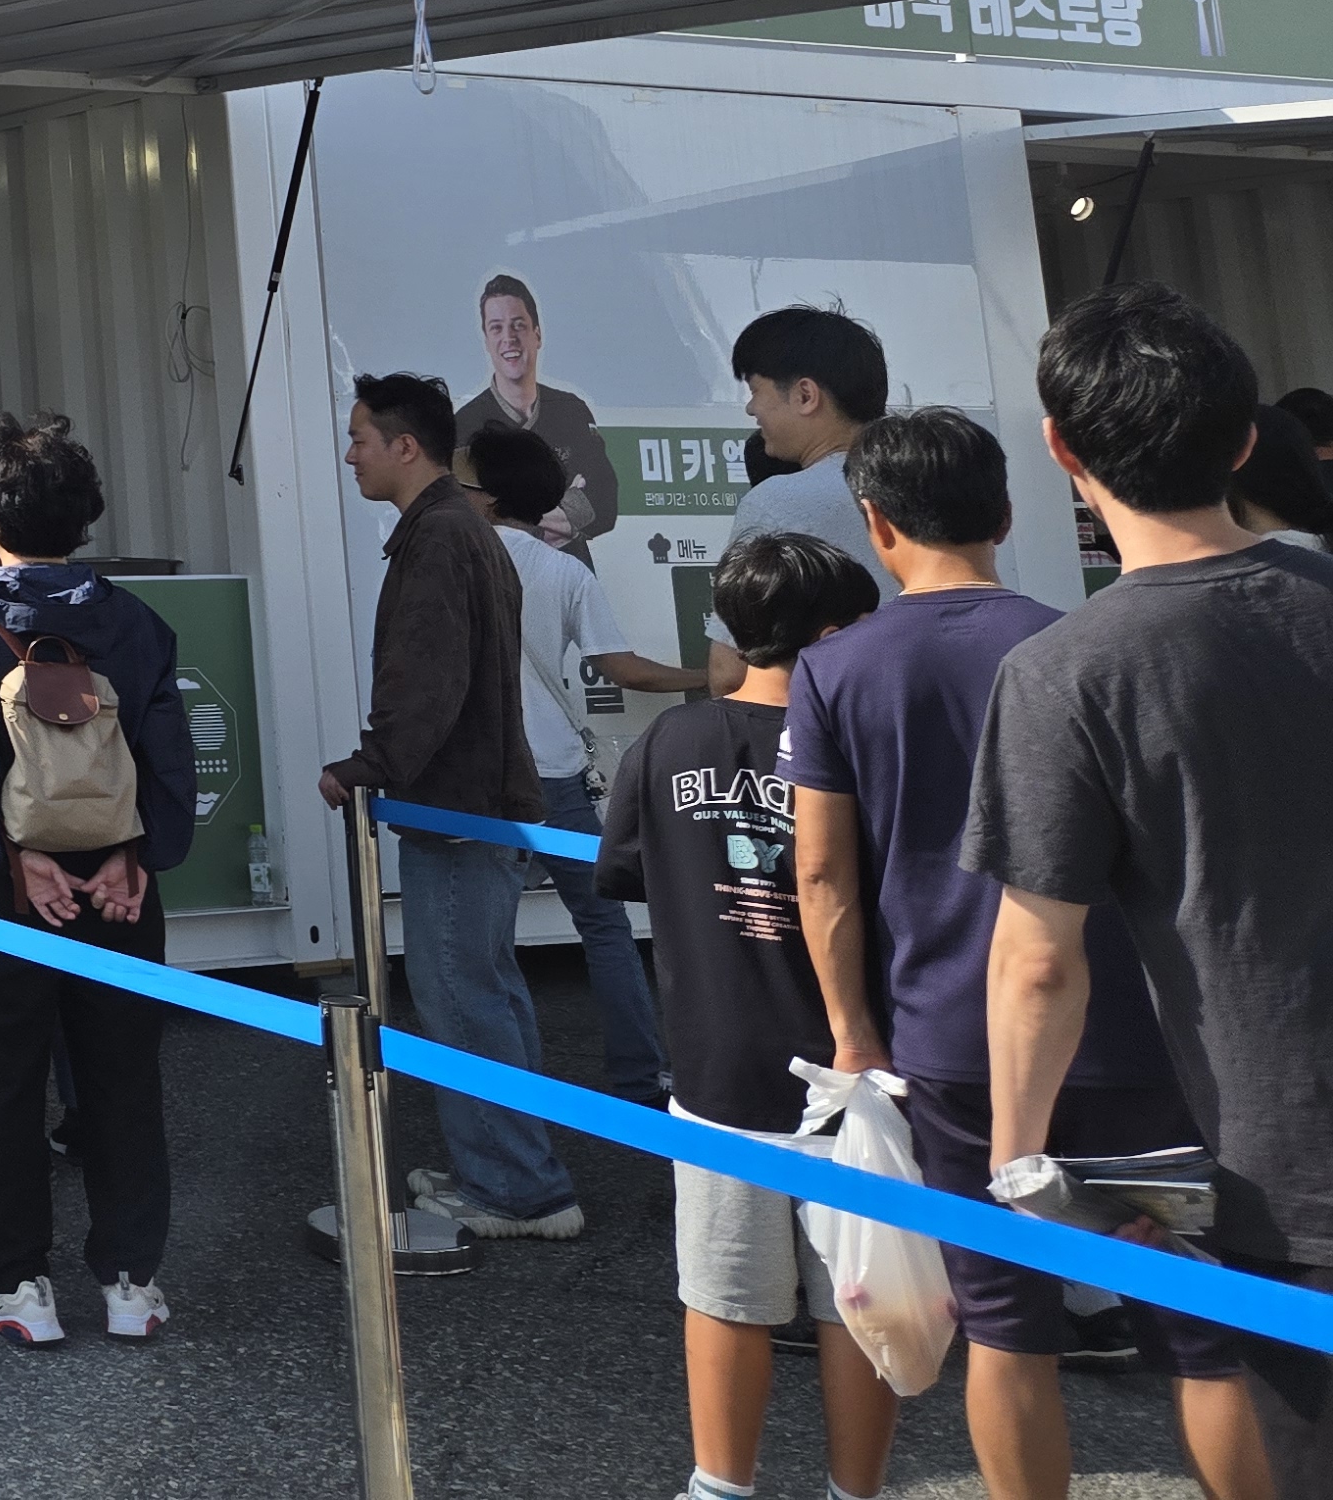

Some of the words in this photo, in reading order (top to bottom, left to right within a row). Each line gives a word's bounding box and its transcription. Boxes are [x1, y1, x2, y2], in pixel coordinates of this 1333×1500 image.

[677, 539, 707, 559] 메뉴
[693, 810, 720, 820] OUR
[723, 810, 767, 823] VALUES
[727, 835, 784, 873] BY
